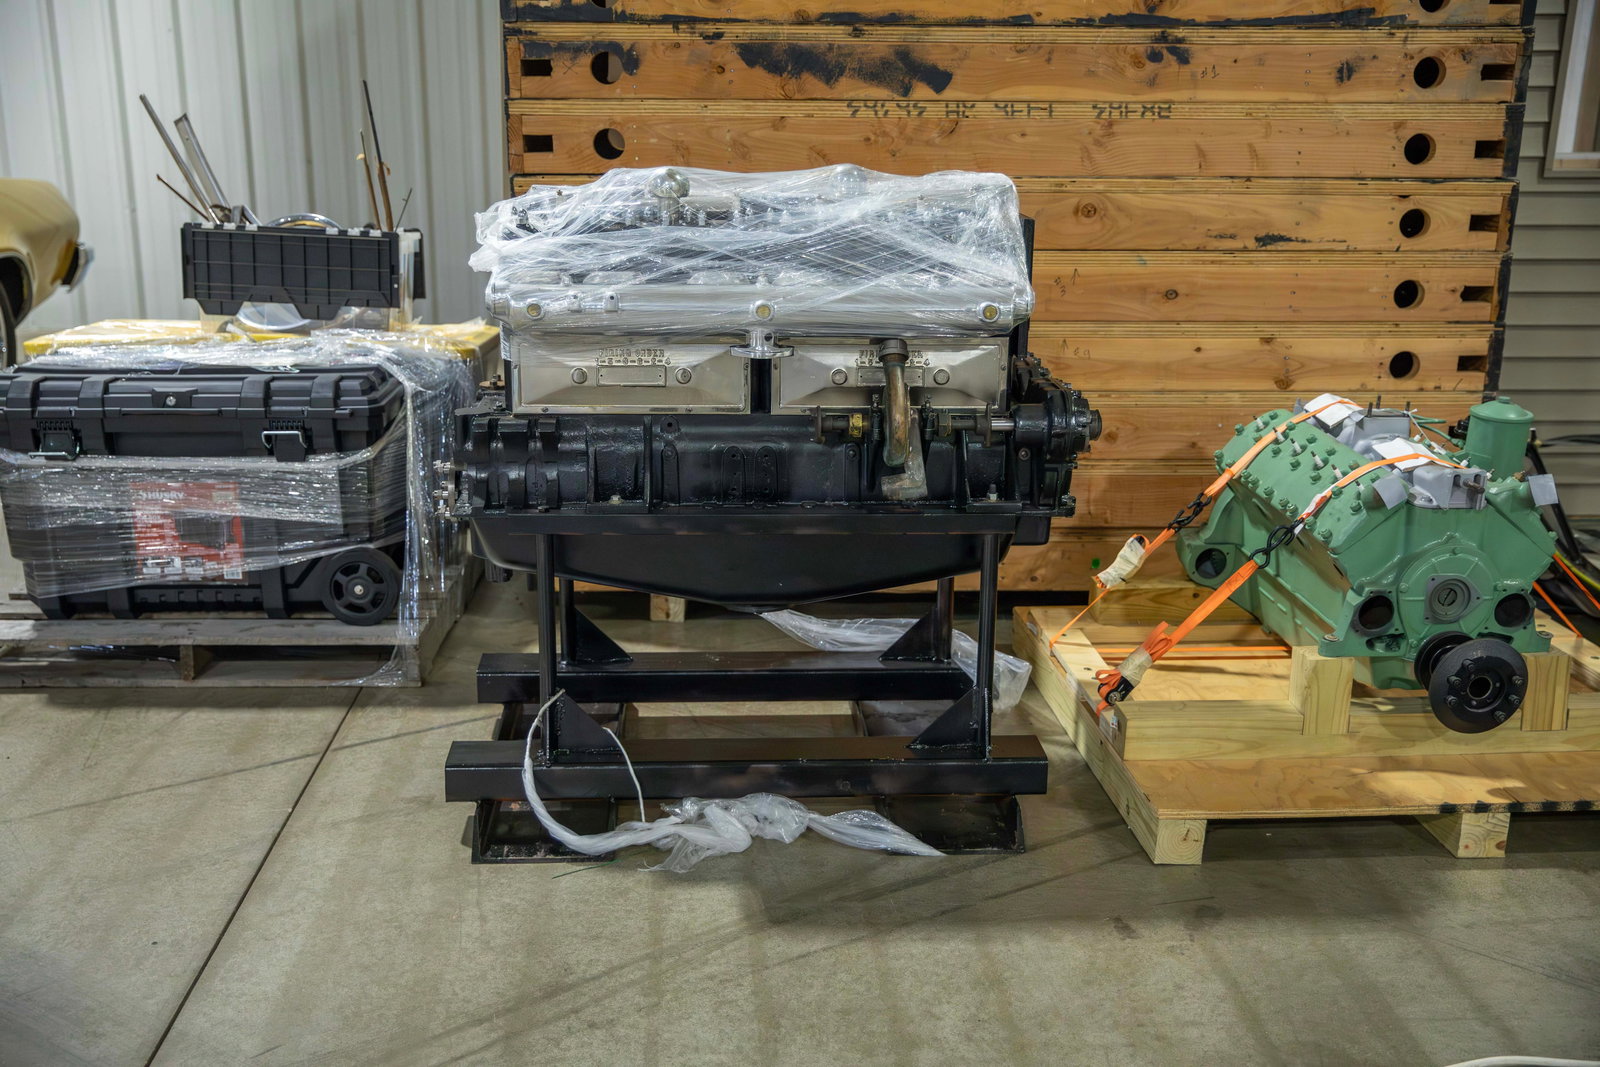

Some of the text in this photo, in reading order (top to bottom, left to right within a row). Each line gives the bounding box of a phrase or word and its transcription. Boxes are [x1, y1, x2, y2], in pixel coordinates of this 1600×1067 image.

[599, 349, 665, 357] FIRING ORDER
[147, 491, 185, 500] HUSKY
